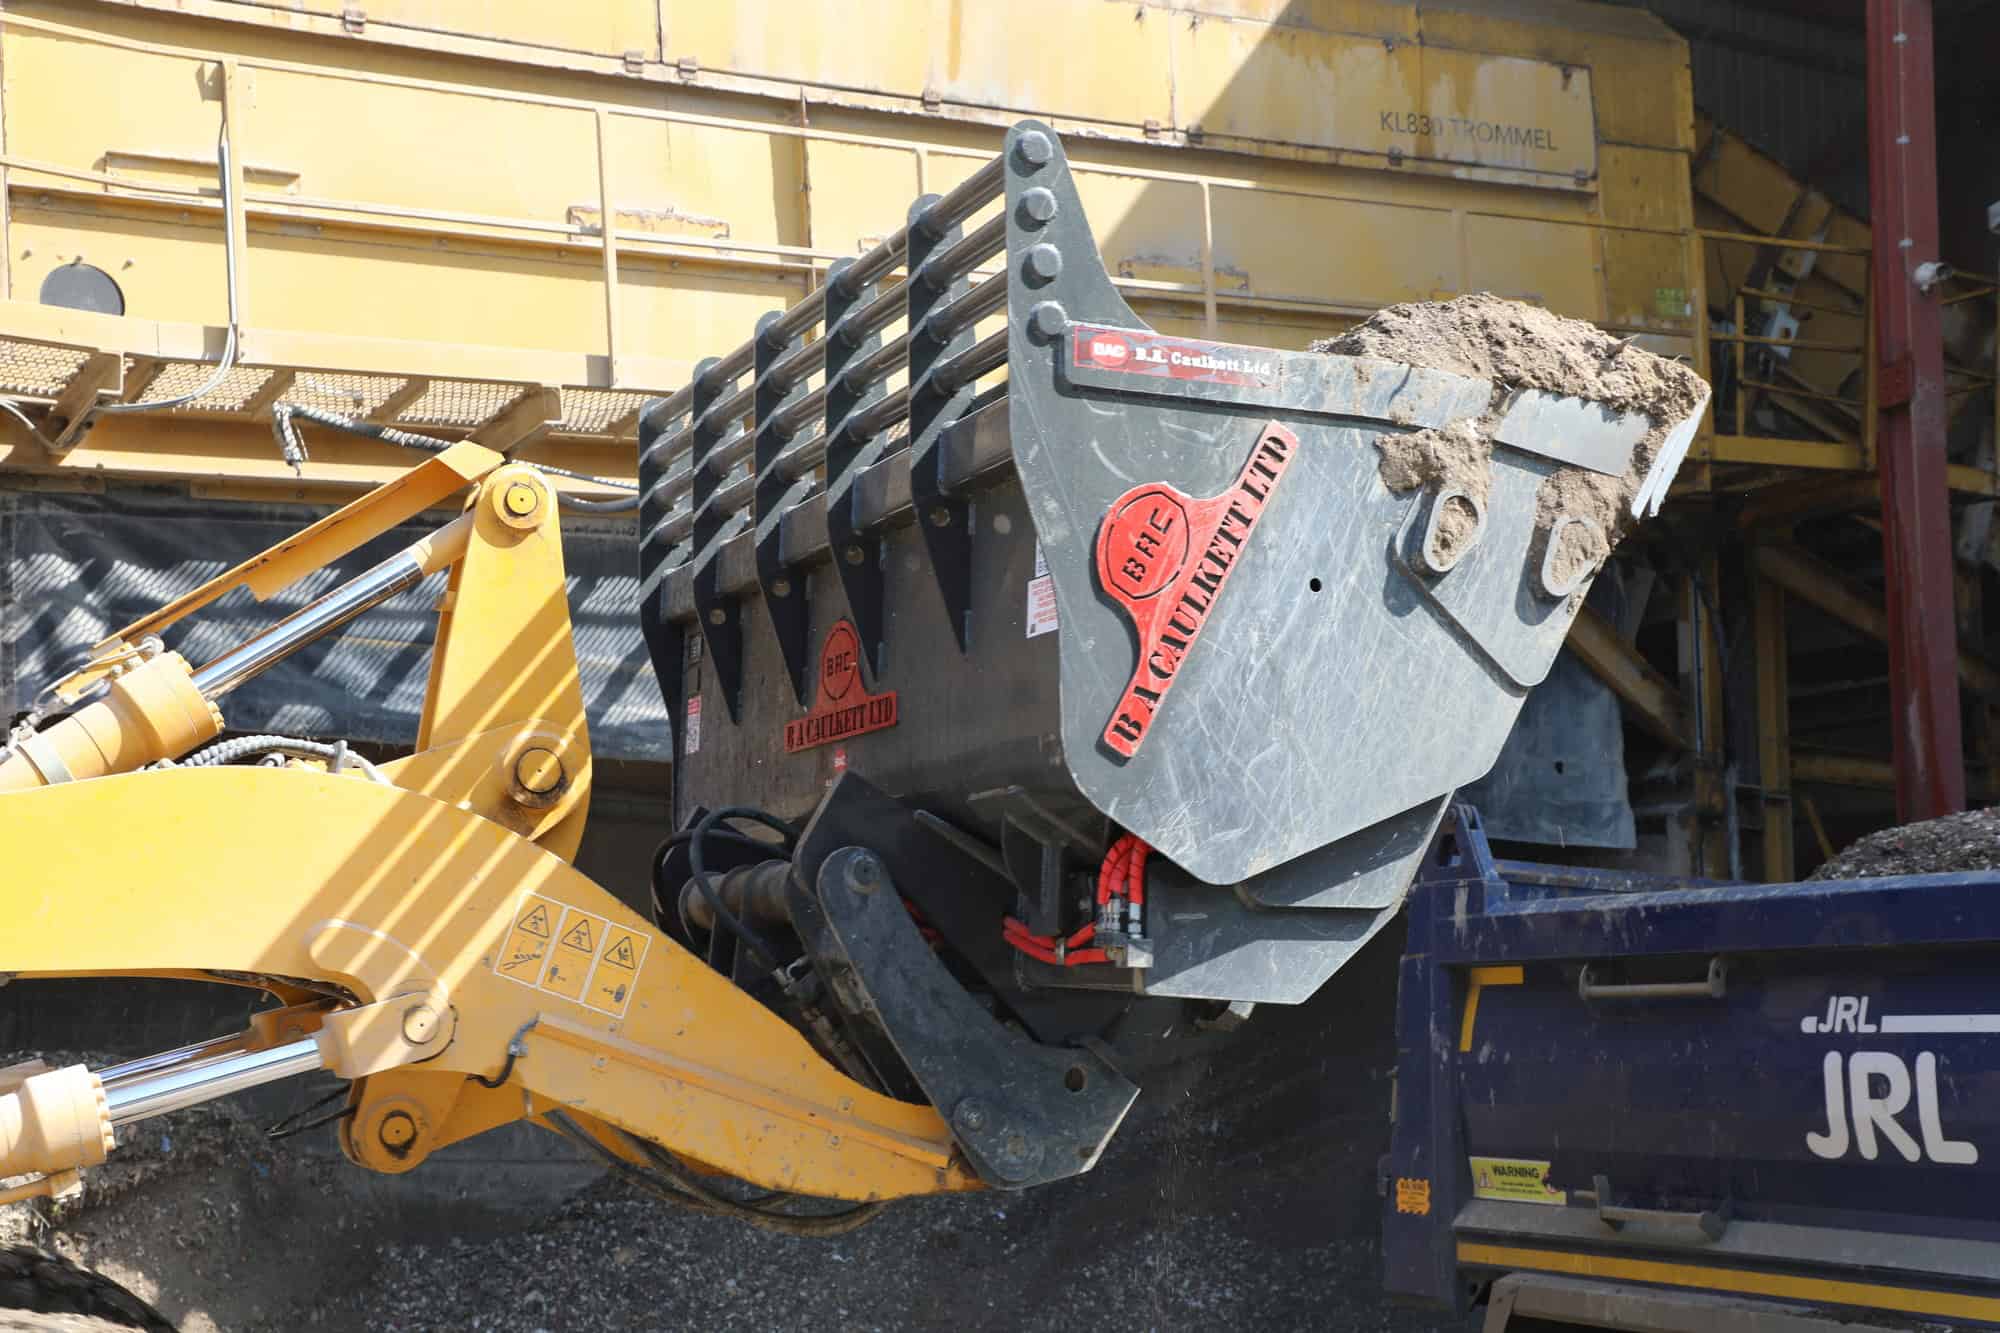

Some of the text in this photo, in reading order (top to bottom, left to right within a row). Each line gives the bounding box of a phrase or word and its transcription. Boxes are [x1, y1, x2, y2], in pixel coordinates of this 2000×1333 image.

[1380, 111, 1560, 151] KL830 TROMMEL
[1171, 351, 1240, 372] Caulkett
[1243, 360, 1270, 375] Ltd
[1112, 435, 1288, 743] B A CAULKETT LTD
[787, 697, 893, 750] B A CAULKETT LTD
[1818, 996, 1877, 1033] JRL
[1806, 1051, 1979, 1165] JRL
[1492, 1165, 1540, 1178] WARNING
